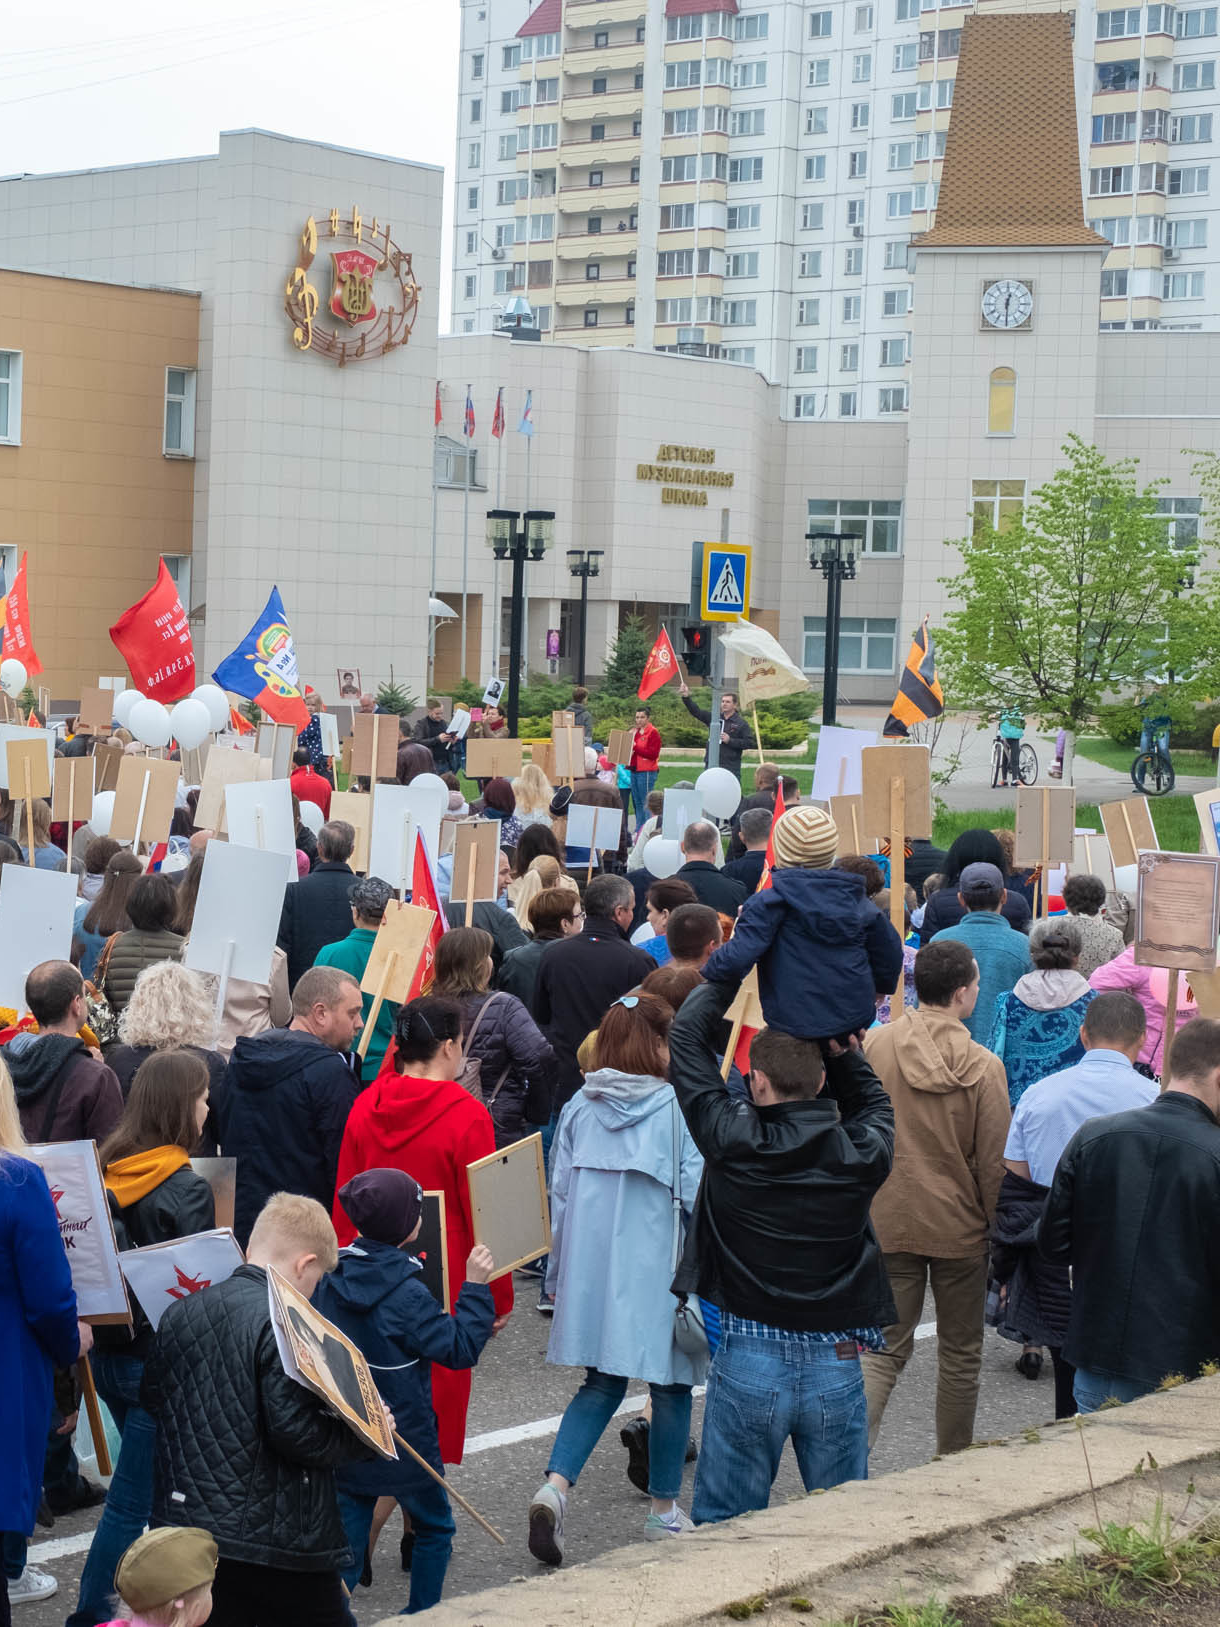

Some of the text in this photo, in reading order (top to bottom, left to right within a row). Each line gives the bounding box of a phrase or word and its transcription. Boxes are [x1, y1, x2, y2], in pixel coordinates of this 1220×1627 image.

[656, 444, 715, 465] ДЕТСКАЯ
[636, 464, 734, 488] МУЗЫКАЛЬНАЯ
[661, 487, 708, 507] ШКОЛА
